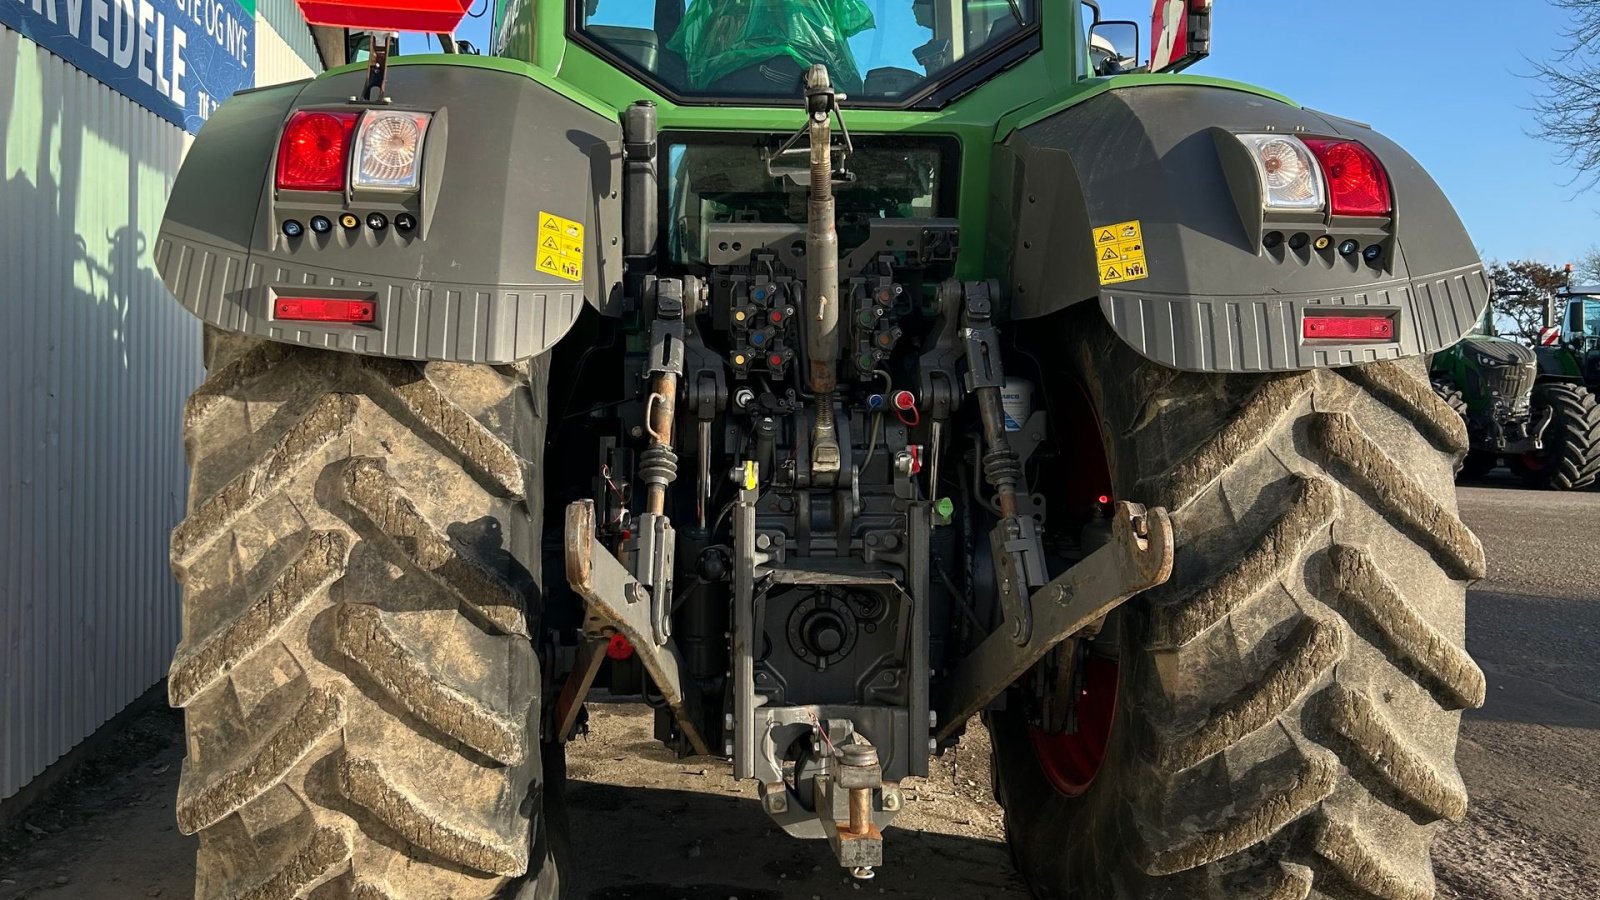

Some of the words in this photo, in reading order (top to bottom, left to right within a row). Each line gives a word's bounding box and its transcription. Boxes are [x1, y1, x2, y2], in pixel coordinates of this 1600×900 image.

[32, 0, 186, 107] EDELE
[205, 0, 224, 46] OG
[226, 12, 248, 68] NYE
